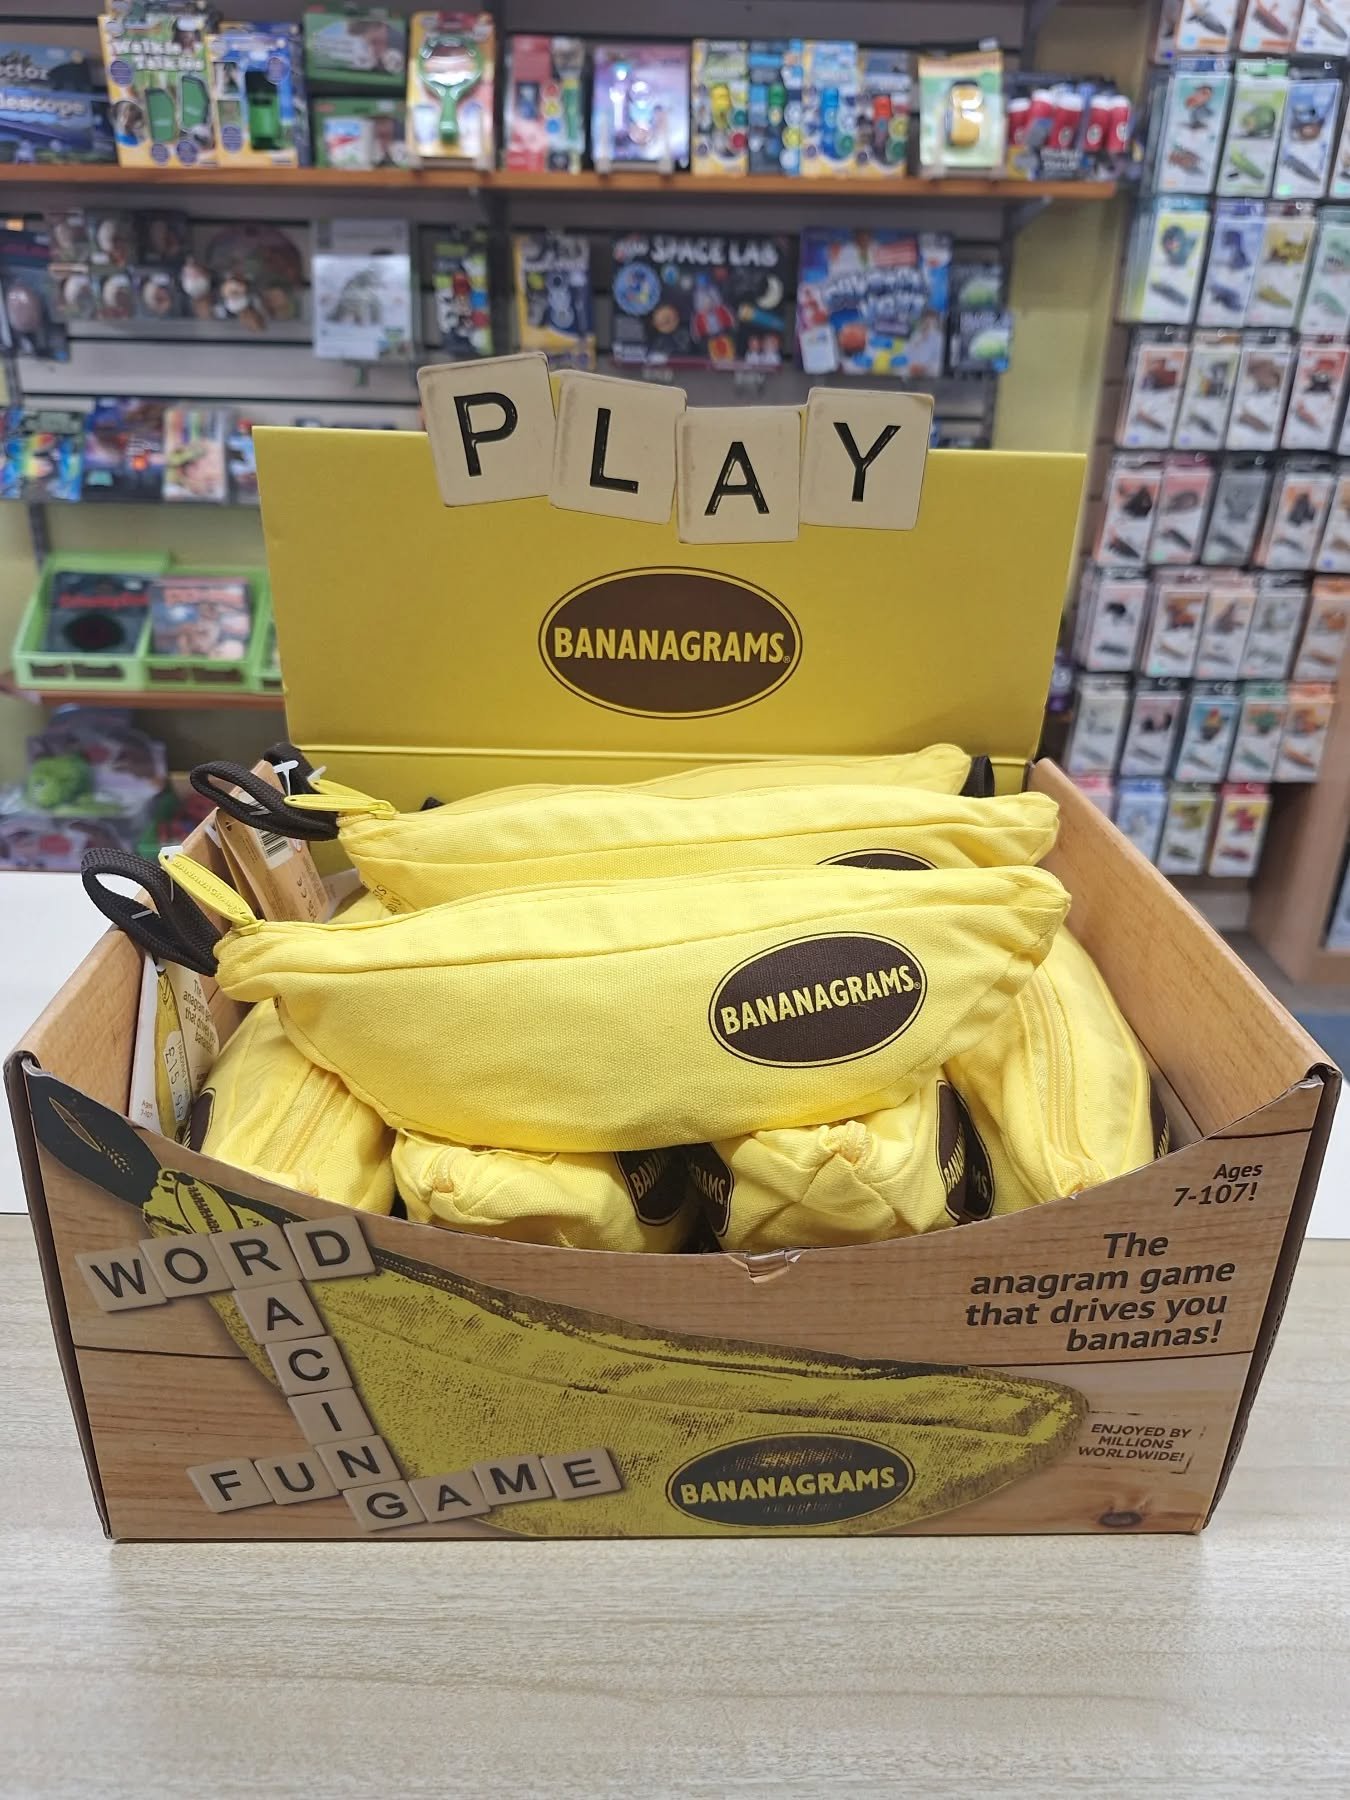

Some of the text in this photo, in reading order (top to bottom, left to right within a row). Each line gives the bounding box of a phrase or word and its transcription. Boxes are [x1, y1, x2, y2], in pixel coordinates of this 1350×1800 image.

[651, 235, 726, 265] SPACE
[728, 239, 779, 267] LAB
[453, 391, 901, 516] PLAY
[553, 626, 787, 664] BANANAGRAMS
[720, 963, 915, 1037] BANANAGRAMS
[1213, 1163, 1263, 1183] Ages
[1173, 1182, 1258, 1207] 7-107!
[1103, 1231, 1169, 1259] The
[89, 1228, 352, 1299] WORD
[970, 1262, 1236, 1299] anagram game
[965, 1295, 1228, 1327] that drives you
[1066, 1319, 1223, 1352] bananas!
[1090, 1423, 1193, 1439] ENJOYED BY
[1098, 1435, 1175, 1449] MILLIONS
[1078, 1446, 1185, 1462] WORLDWIDE!
[209, 1446, 602, 1520] FUN GAME
[680, 1466, 896, 1505] BANANAGRAMS
